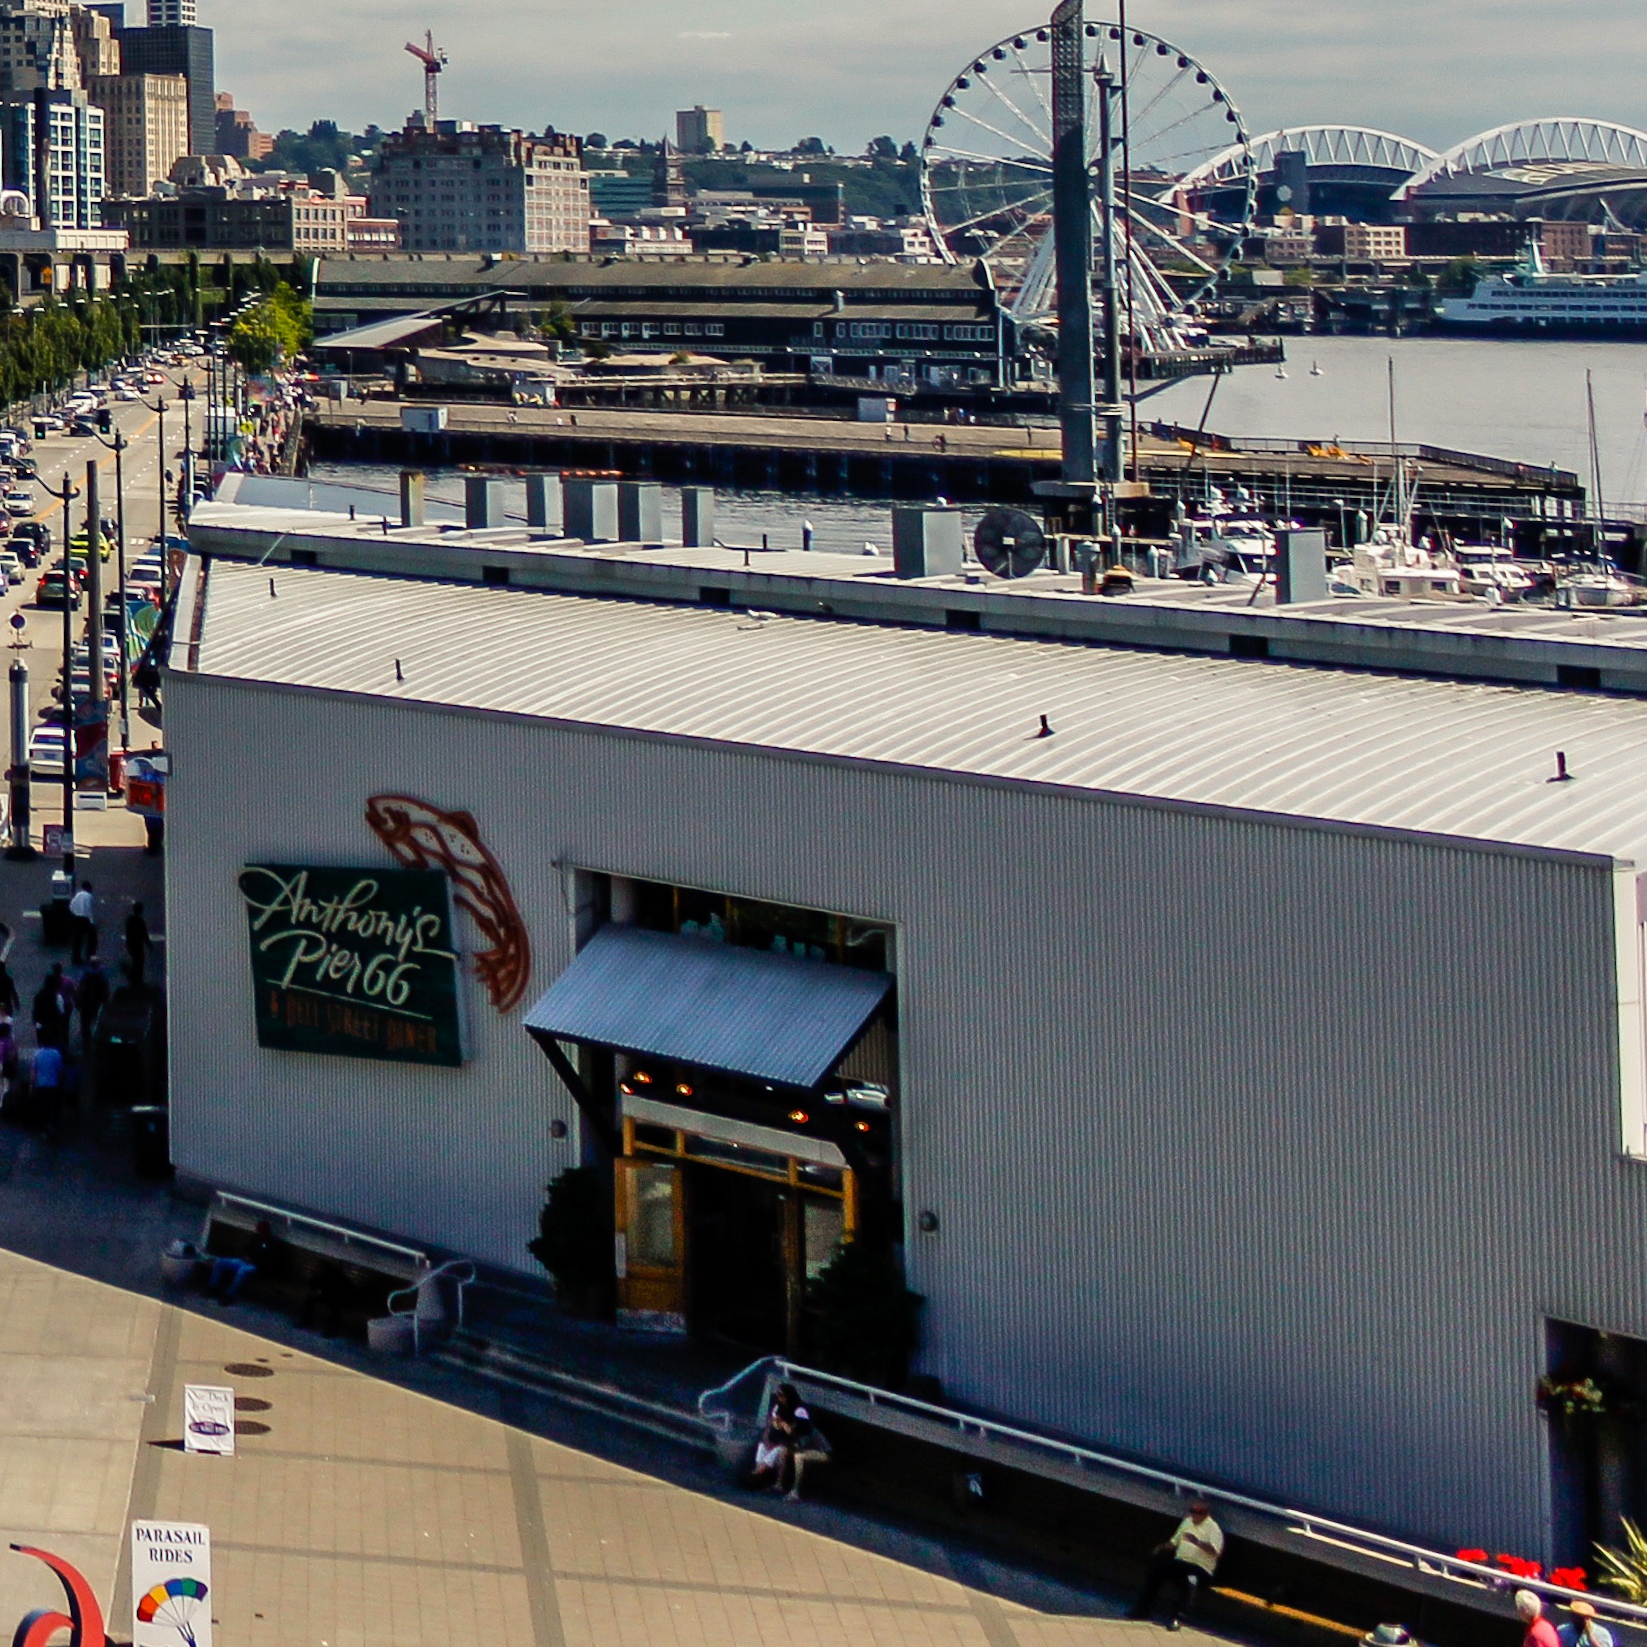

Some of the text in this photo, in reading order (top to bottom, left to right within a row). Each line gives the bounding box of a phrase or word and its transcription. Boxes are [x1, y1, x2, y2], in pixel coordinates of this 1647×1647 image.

[238, 866, 457, 962] Anthony's
[260, 930, 422, 1005] Pier 66
[135, 1527, 206, 1546] PARASAIL
[149, 1548, 193, 1564] RIDES
